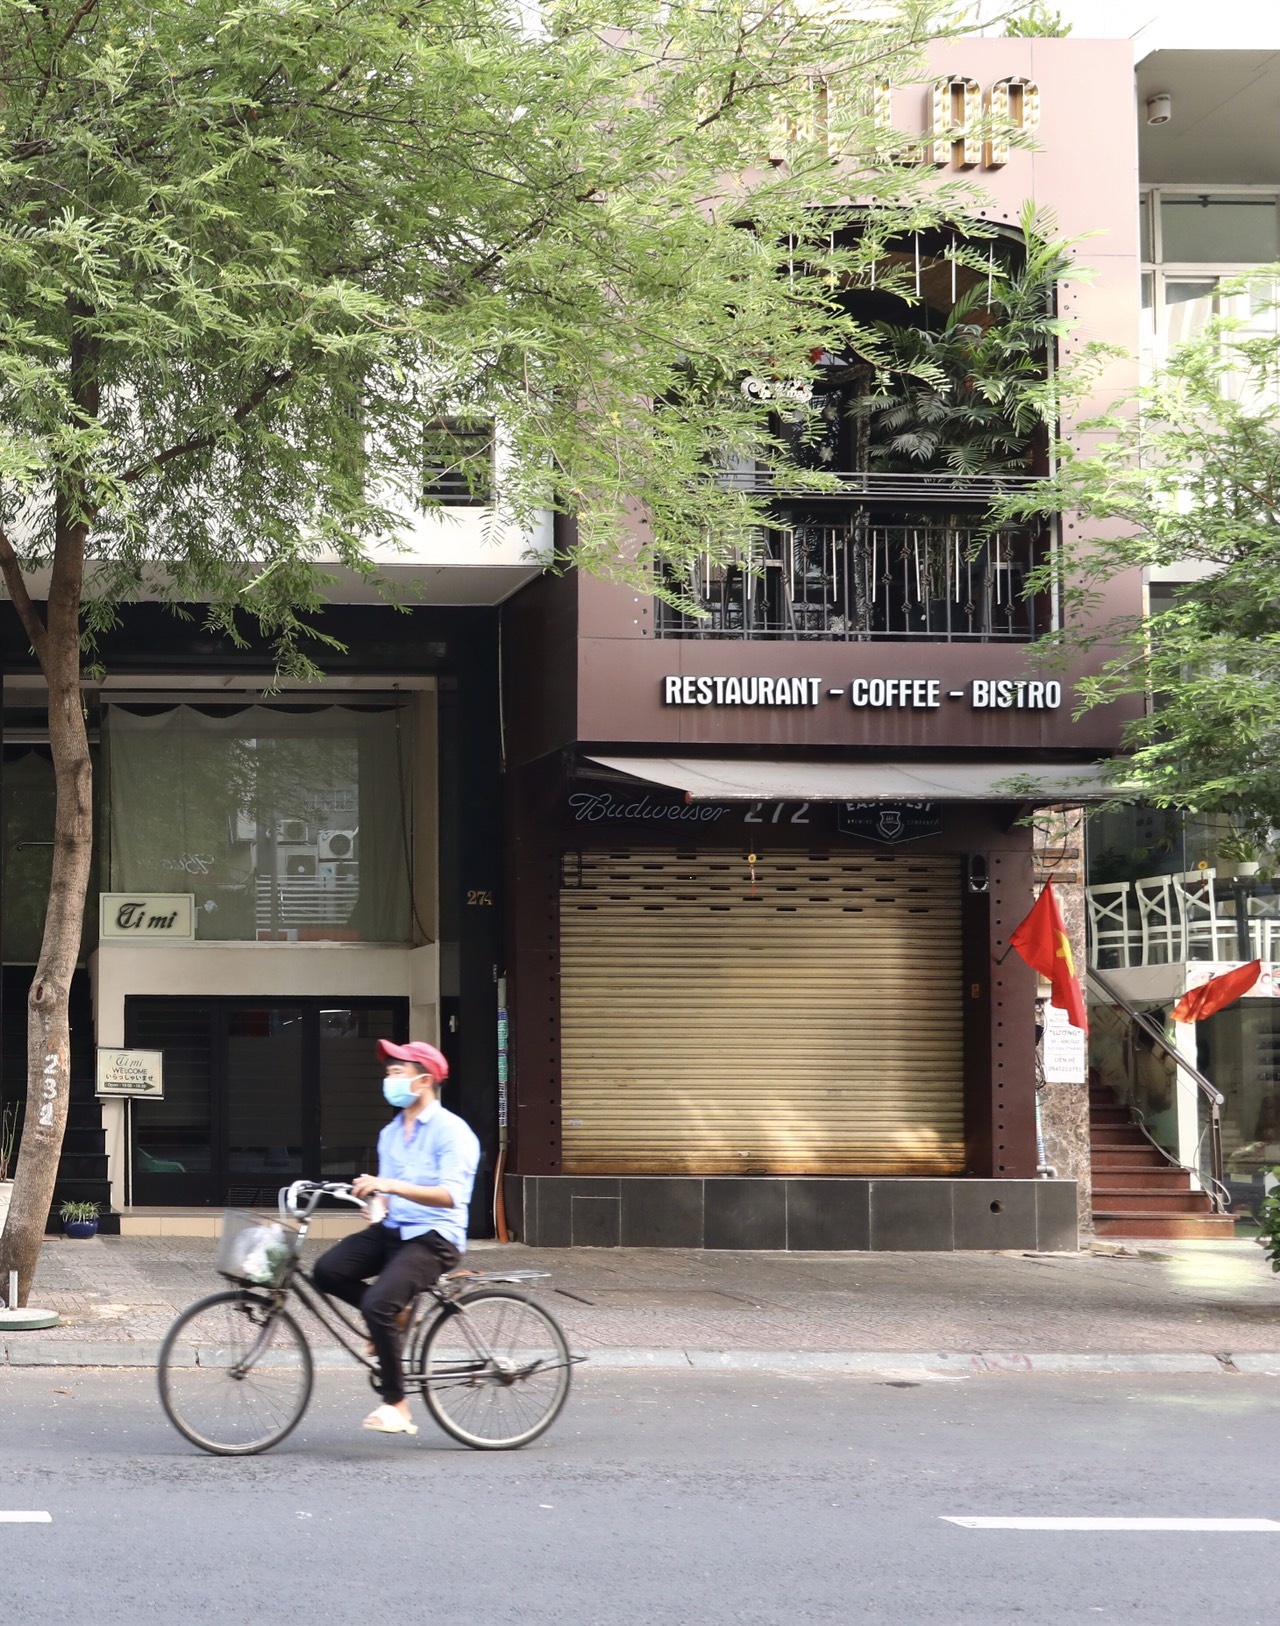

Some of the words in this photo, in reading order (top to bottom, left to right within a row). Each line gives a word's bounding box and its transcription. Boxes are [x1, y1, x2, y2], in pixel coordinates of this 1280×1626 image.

[665, 676, 822, 705] RESTAURANT
[852, 677, 941, 708] COFFEE
[972, 679, 1062, 709] BISTRO
[568, 792, 732, 821] Budweiser
[466, 890, 493, 906] 274
[105, 1074, 154, 1082] いらっしゃいませ
[112, 1067, 148, 1075] WELCOME
